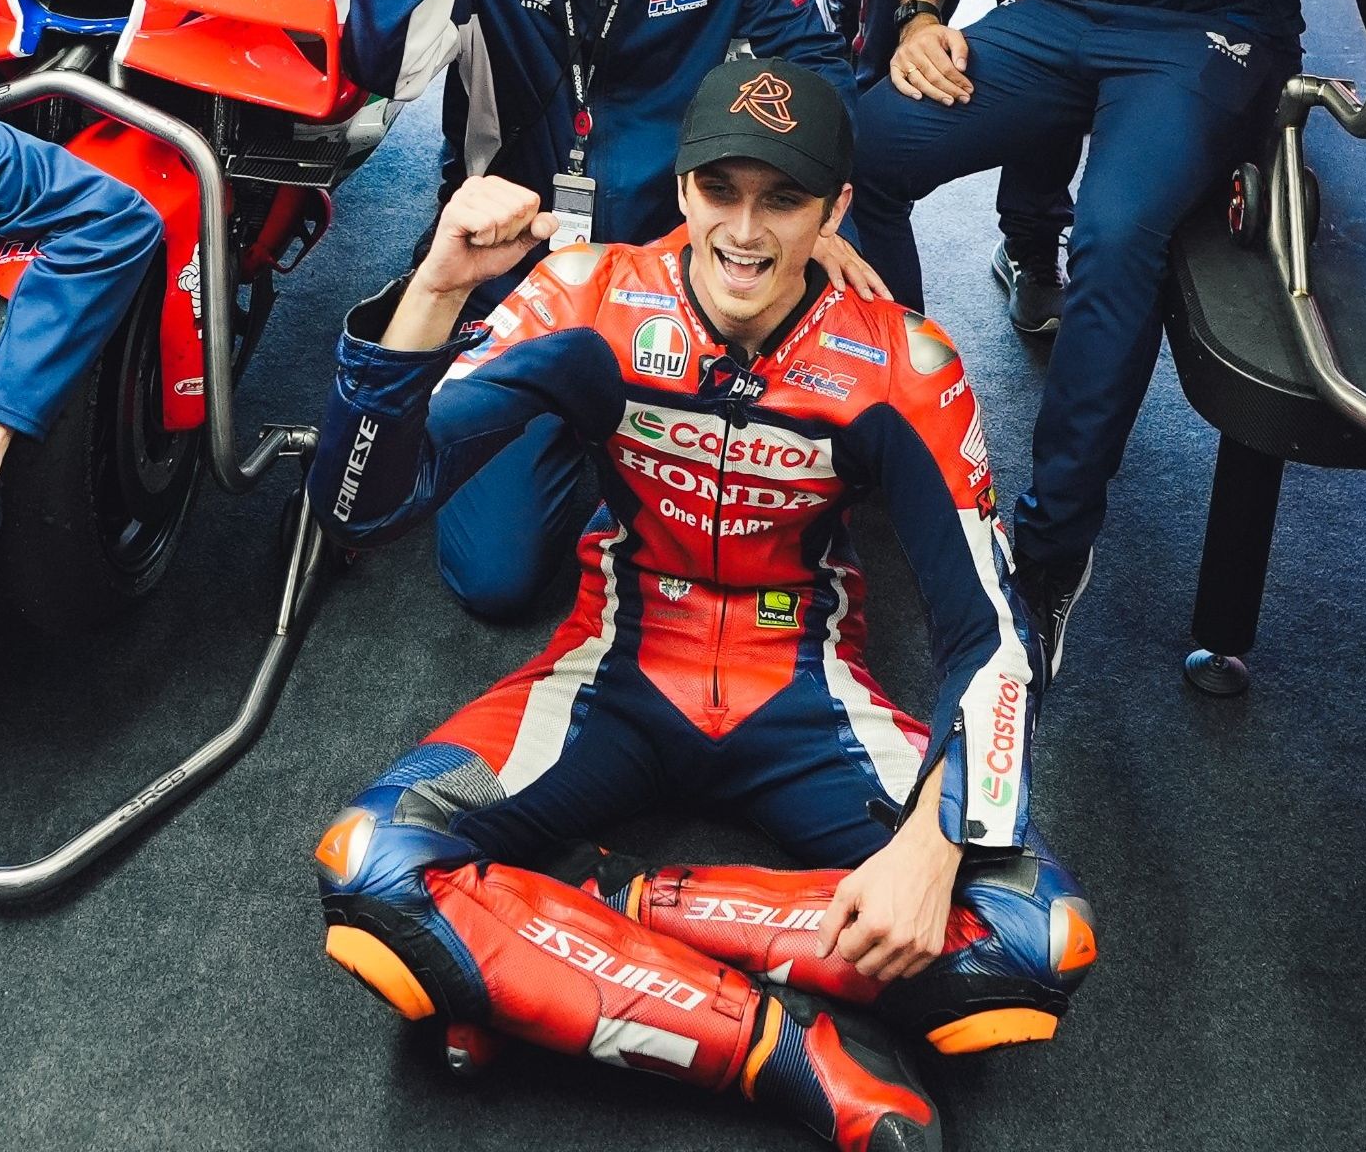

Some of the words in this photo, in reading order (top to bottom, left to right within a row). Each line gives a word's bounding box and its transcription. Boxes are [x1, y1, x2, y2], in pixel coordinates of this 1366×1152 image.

[628, 294, 673, 307] MICHELIN
[659, 250, 709, 346] HONDA
[638, 350, 682, 376] agv
[783, 359, 858, 398] HRC
[939, 373, 970, 409] DAIN
[333, 415, 379, 523] DAINESE
[668, 421, 820, 470] Castrol
[618, 445, 828, 511] HONDA
[659, 498, 697, 528] One
[700, 513, 775, 538] HEART
[985, 672, 1021, 774] Castrol
[517, 917, 708, 1012] DAINESE
